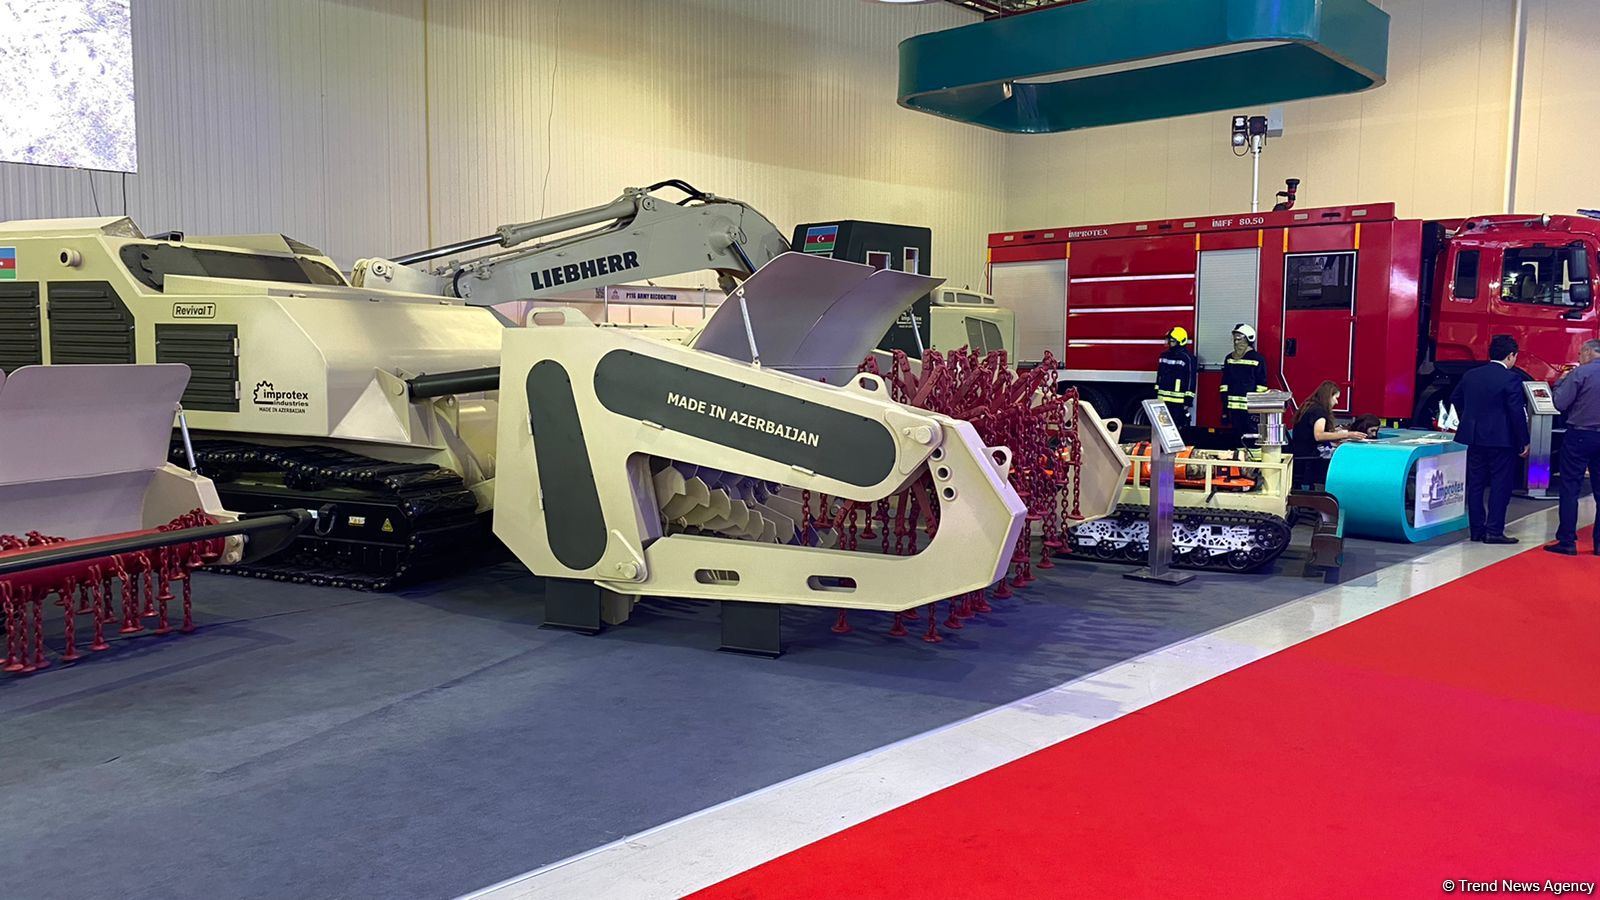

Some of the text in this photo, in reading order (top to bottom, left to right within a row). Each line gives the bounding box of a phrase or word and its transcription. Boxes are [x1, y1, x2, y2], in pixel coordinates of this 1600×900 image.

[1239, 217, 1264, 226] 80.50
[530, 251, 640, 291] LIEBHERR
[175, 305, 213, 315] Revival T
[263, 389, 309, 401] improtex
[667, 391, 820, 448] MADE IN AZERBAIJAN
